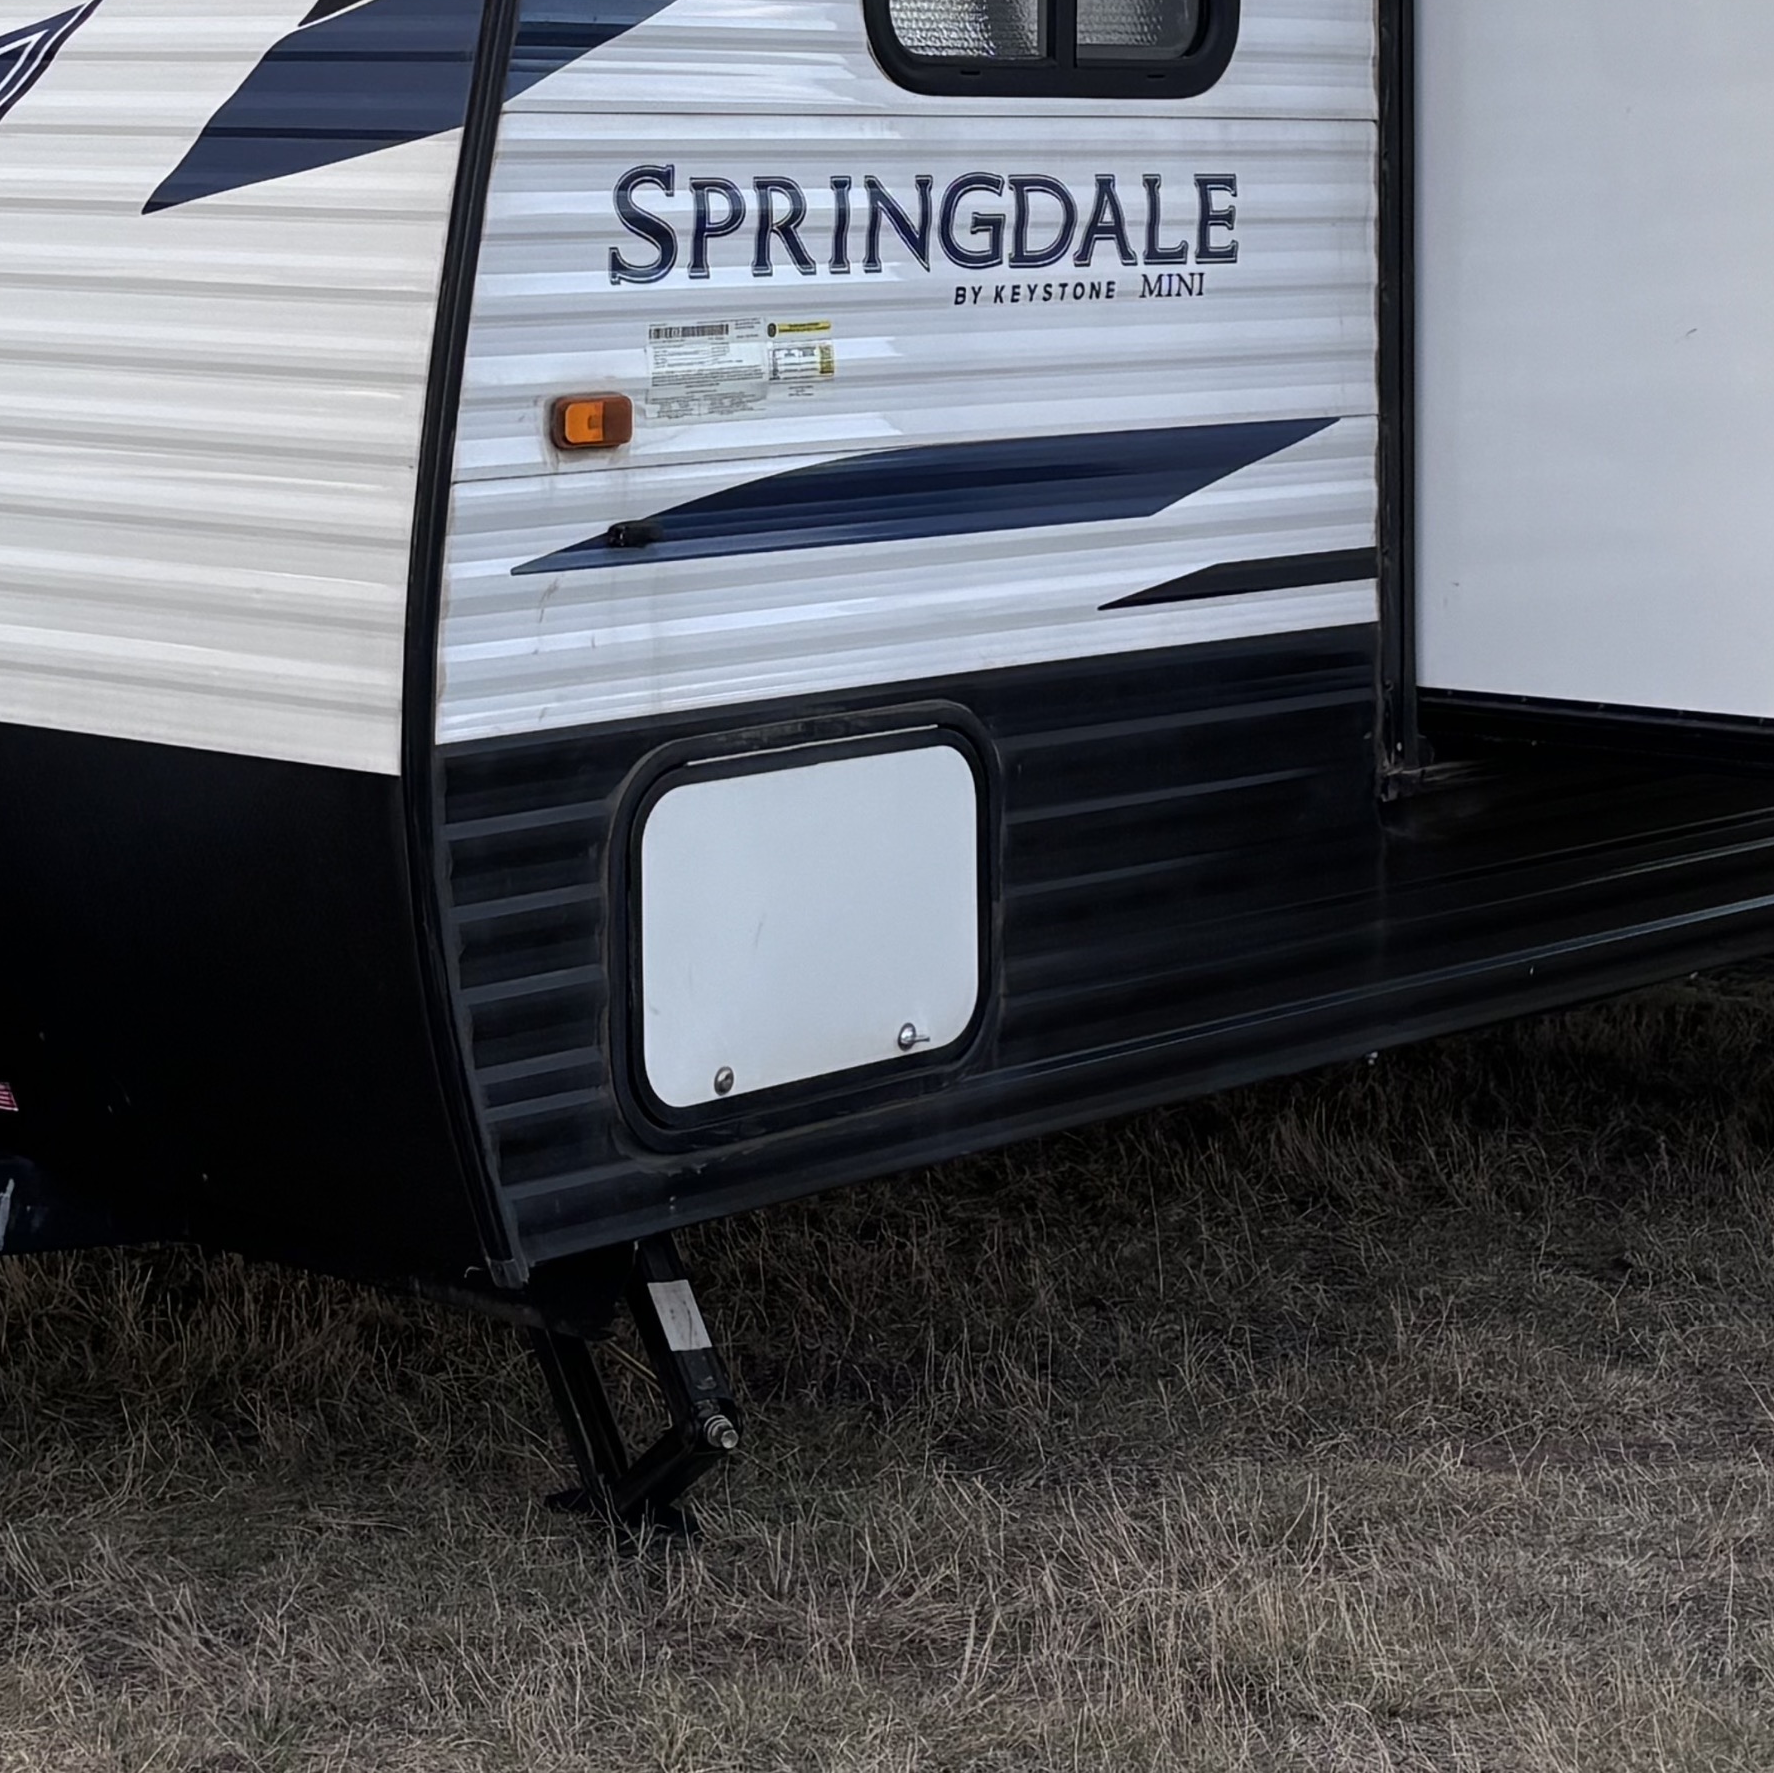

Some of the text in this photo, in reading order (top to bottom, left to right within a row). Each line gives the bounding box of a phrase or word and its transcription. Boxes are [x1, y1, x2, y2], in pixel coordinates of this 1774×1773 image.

[608, 163, 1239, 285] SPRINGDALE
[953, 280, 1117, 305] BY KEYSTONE
[1138, 272, 1206, 299] MINI
